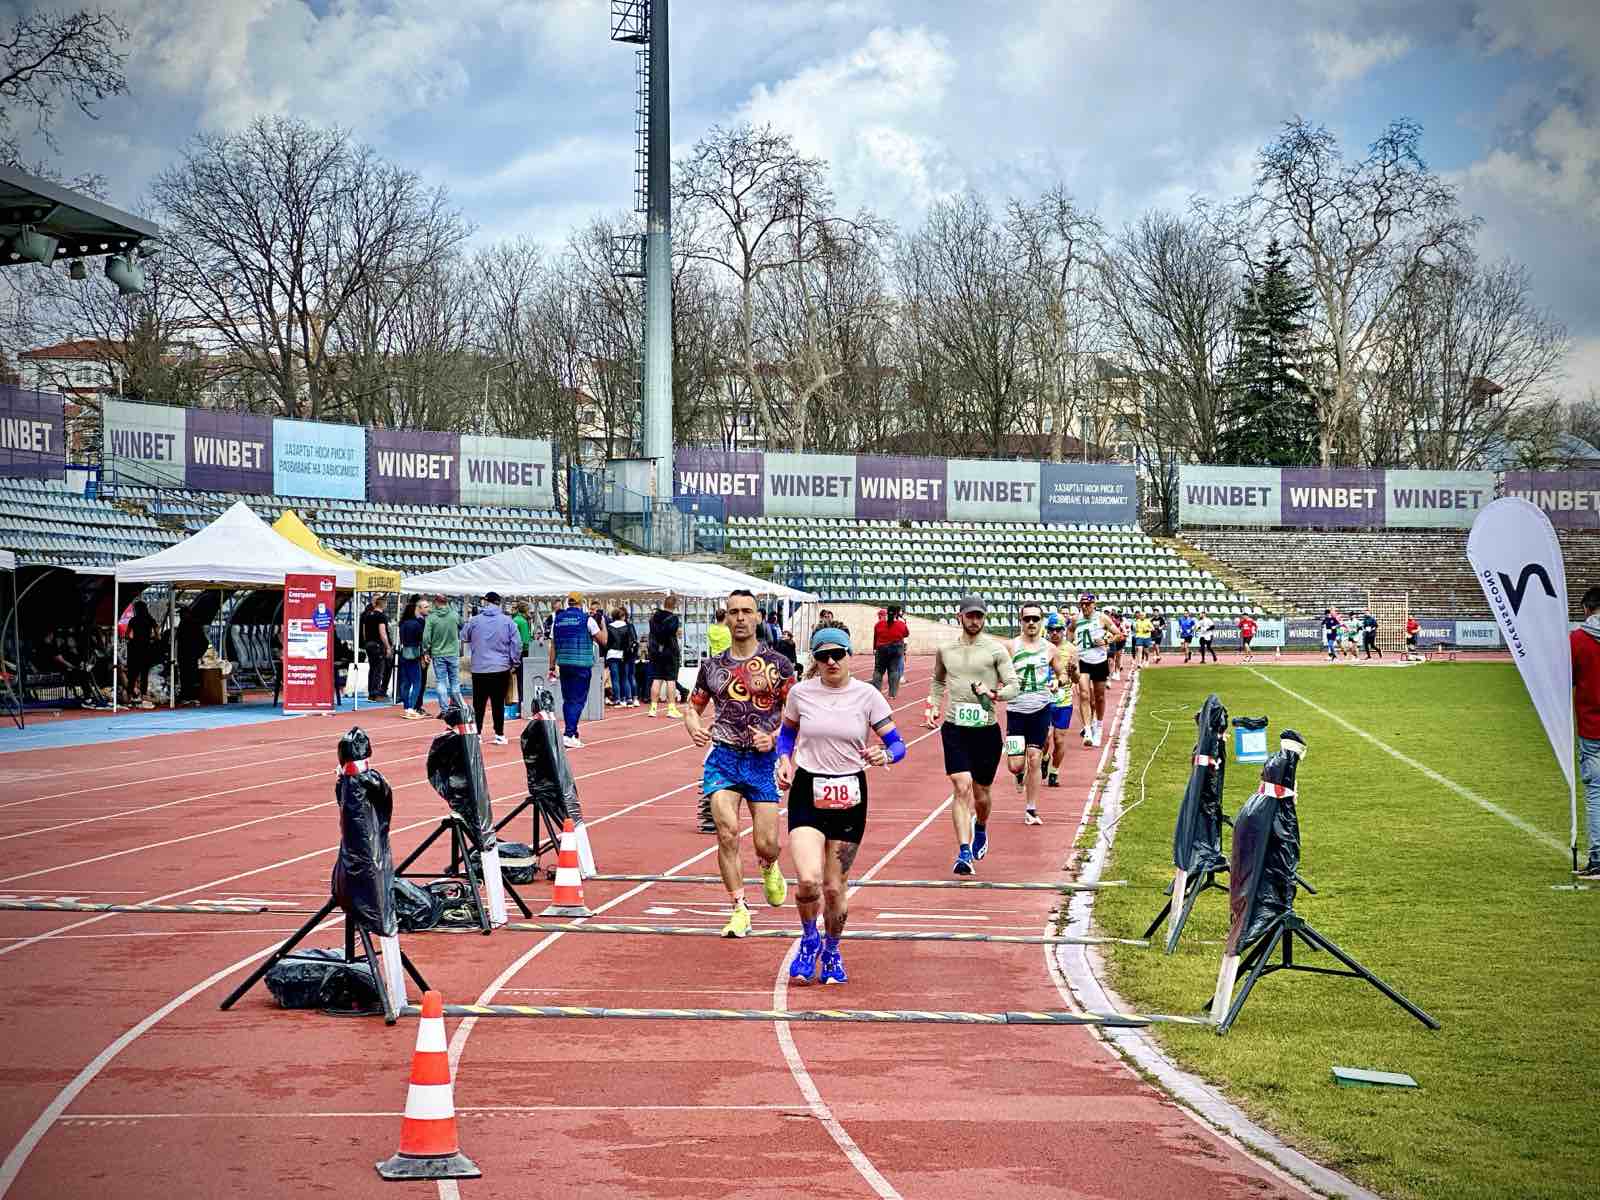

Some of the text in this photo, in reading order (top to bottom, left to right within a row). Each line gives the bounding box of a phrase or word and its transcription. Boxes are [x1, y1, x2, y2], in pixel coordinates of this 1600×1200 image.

[110, 429, 176, 461] WINBET
[193, 436, 264, 468] WINBET
[377, 451, 453, 480] WINBET
[467, 459, 545, 487] WINBET
[679, 471, 759, 496] WINBET
[770, 474, 852, 498] WINBET
[861, 476, 942, 501] WINBET
[954, 480, 1036, 503] WINBET
[1186, 485, 1272, 507] WINBET
[1289, 487, 1377, 508] WINBET
[1393, 488, 1482, 509] WINBET
[1254, 629, 1280, 639] INBET
[1462, 629, 1495, 638] WINBET
[959, 709, 980, 721] 630
[823, 785, 849, 801] 218
